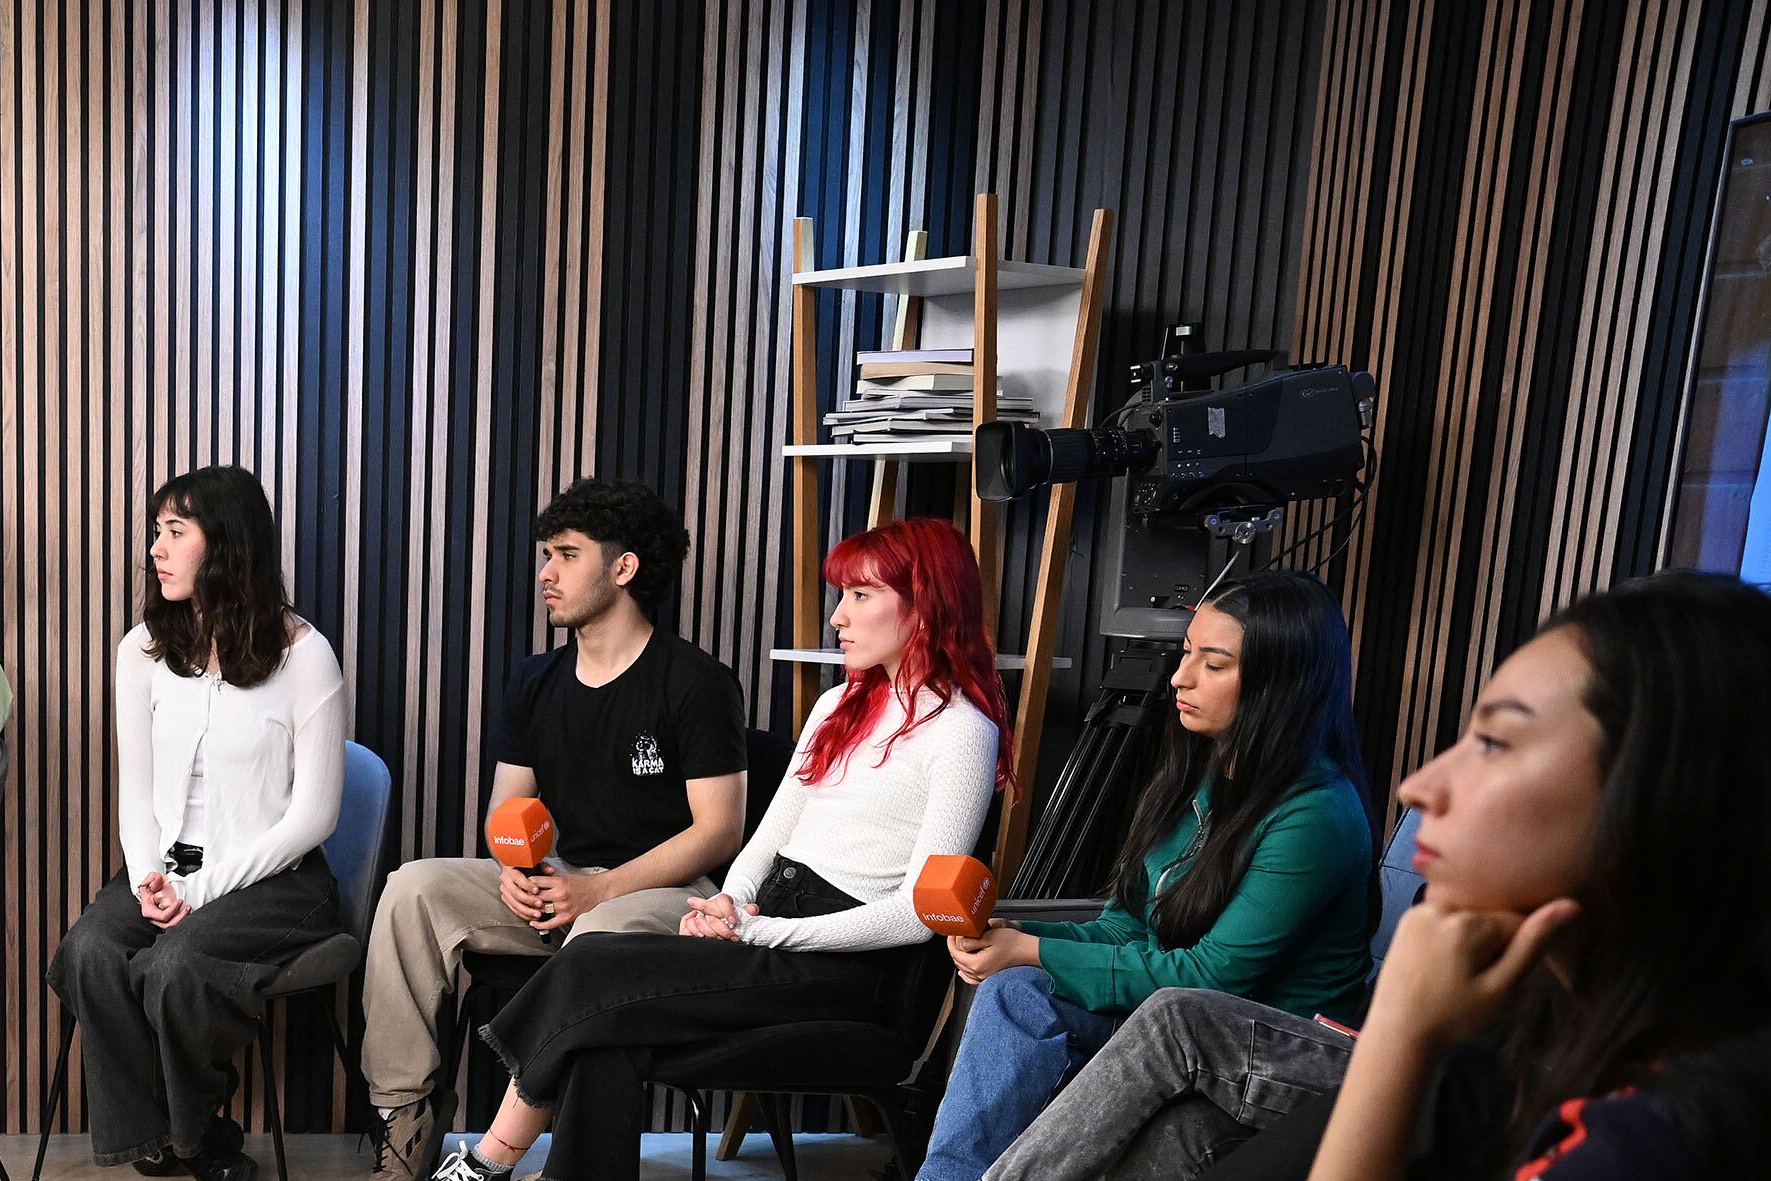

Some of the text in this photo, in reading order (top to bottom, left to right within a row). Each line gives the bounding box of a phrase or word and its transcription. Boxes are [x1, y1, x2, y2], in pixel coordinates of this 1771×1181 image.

[632, 757, 664, 769] KARMA
[493, 836, 525, 846] infobae
[971, 886, 986, 915] unicef
[922, 913, 964, 923] infobae
